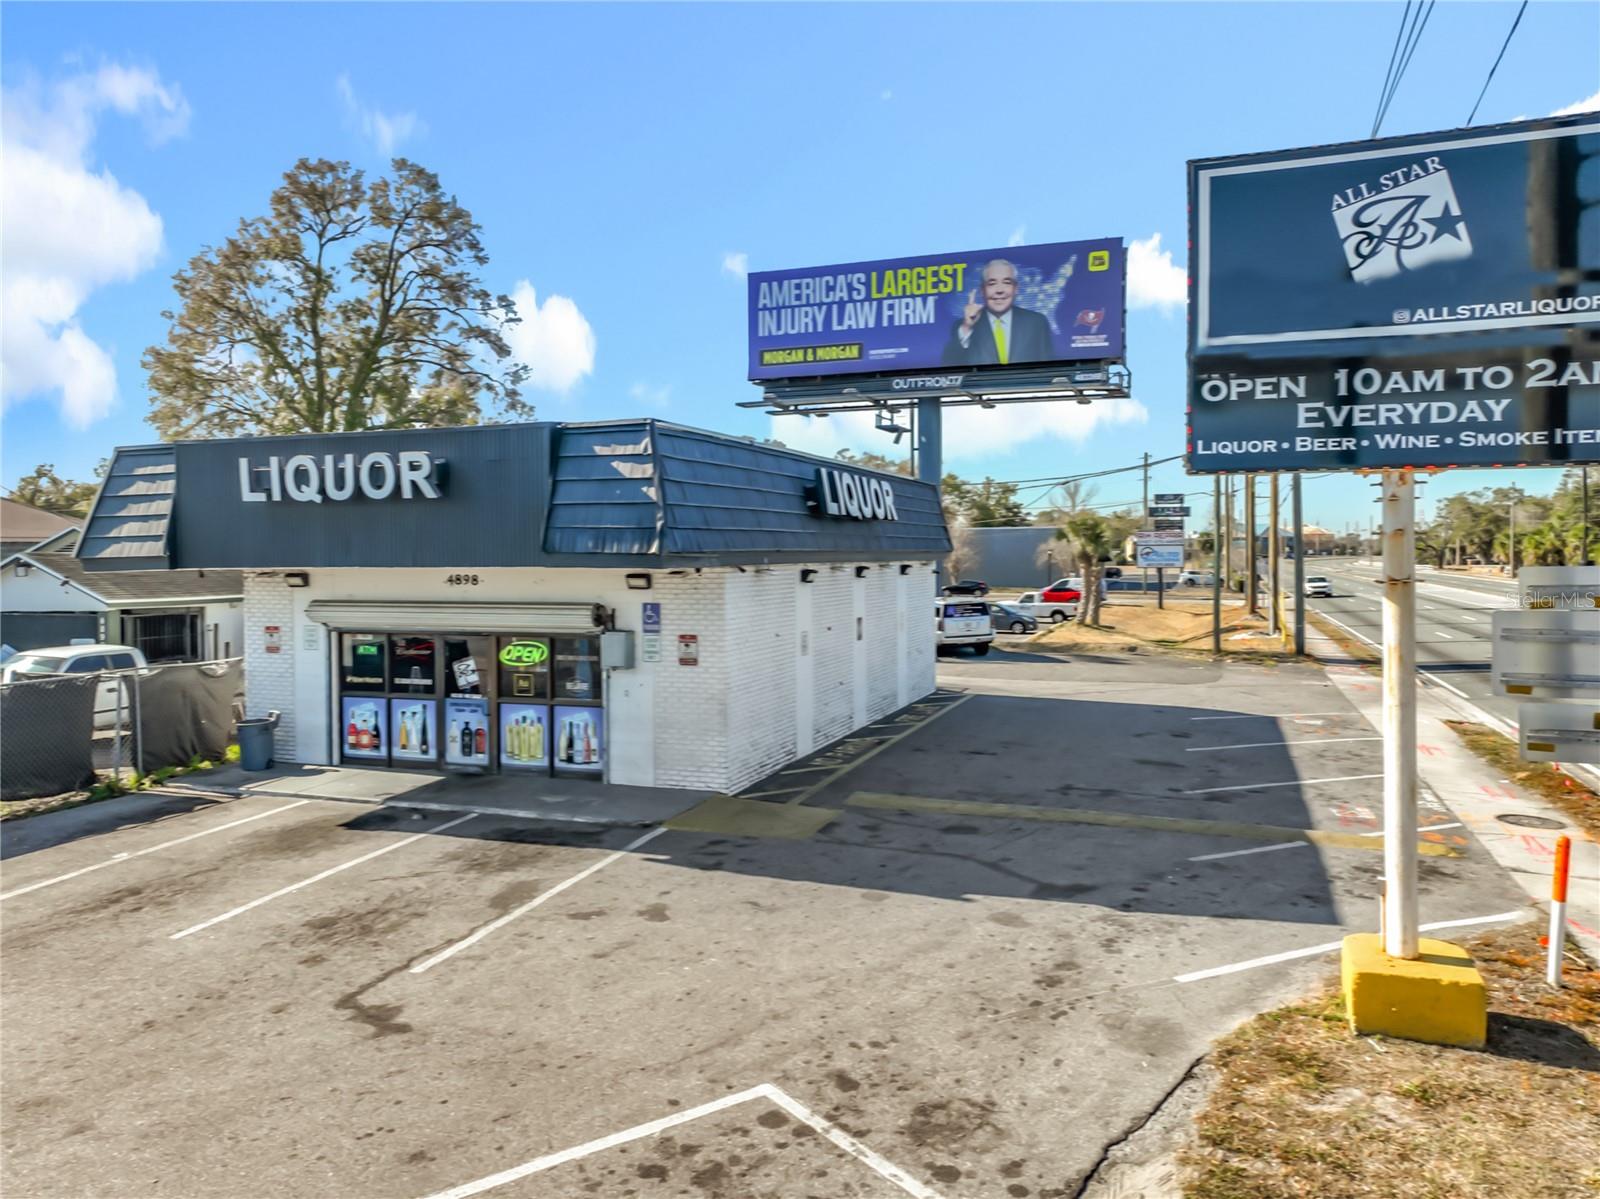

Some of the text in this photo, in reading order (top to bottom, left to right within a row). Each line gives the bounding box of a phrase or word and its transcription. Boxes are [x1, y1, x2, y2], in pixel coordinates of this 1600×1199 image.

[1331, 156, 1446, 211] ALL STAR
[758, 263, 967, 309] AMERICA'S LARGEST
[758, 297, 936, 337] INJURY LAW FIRM
[763, 349, 804, 365] MORGAN
[806, 347, 814, 361] &
[816, 344, 860, 361] MORGAN
[1201, 358, 1600, 402] OPEN 10AM TO 2A
[1297, 399, 1512, 428] EVERYDAY
[1197, 428, 1600, 455] LIQUOR BEER WINE SMOKE ITE
[239, 451, 441, 503] LIQUOR
[820, 467, 898, 520] LIQUOR
[447, 574, 479, 586] 4898
[504, 645, 543, 662] OPEN
